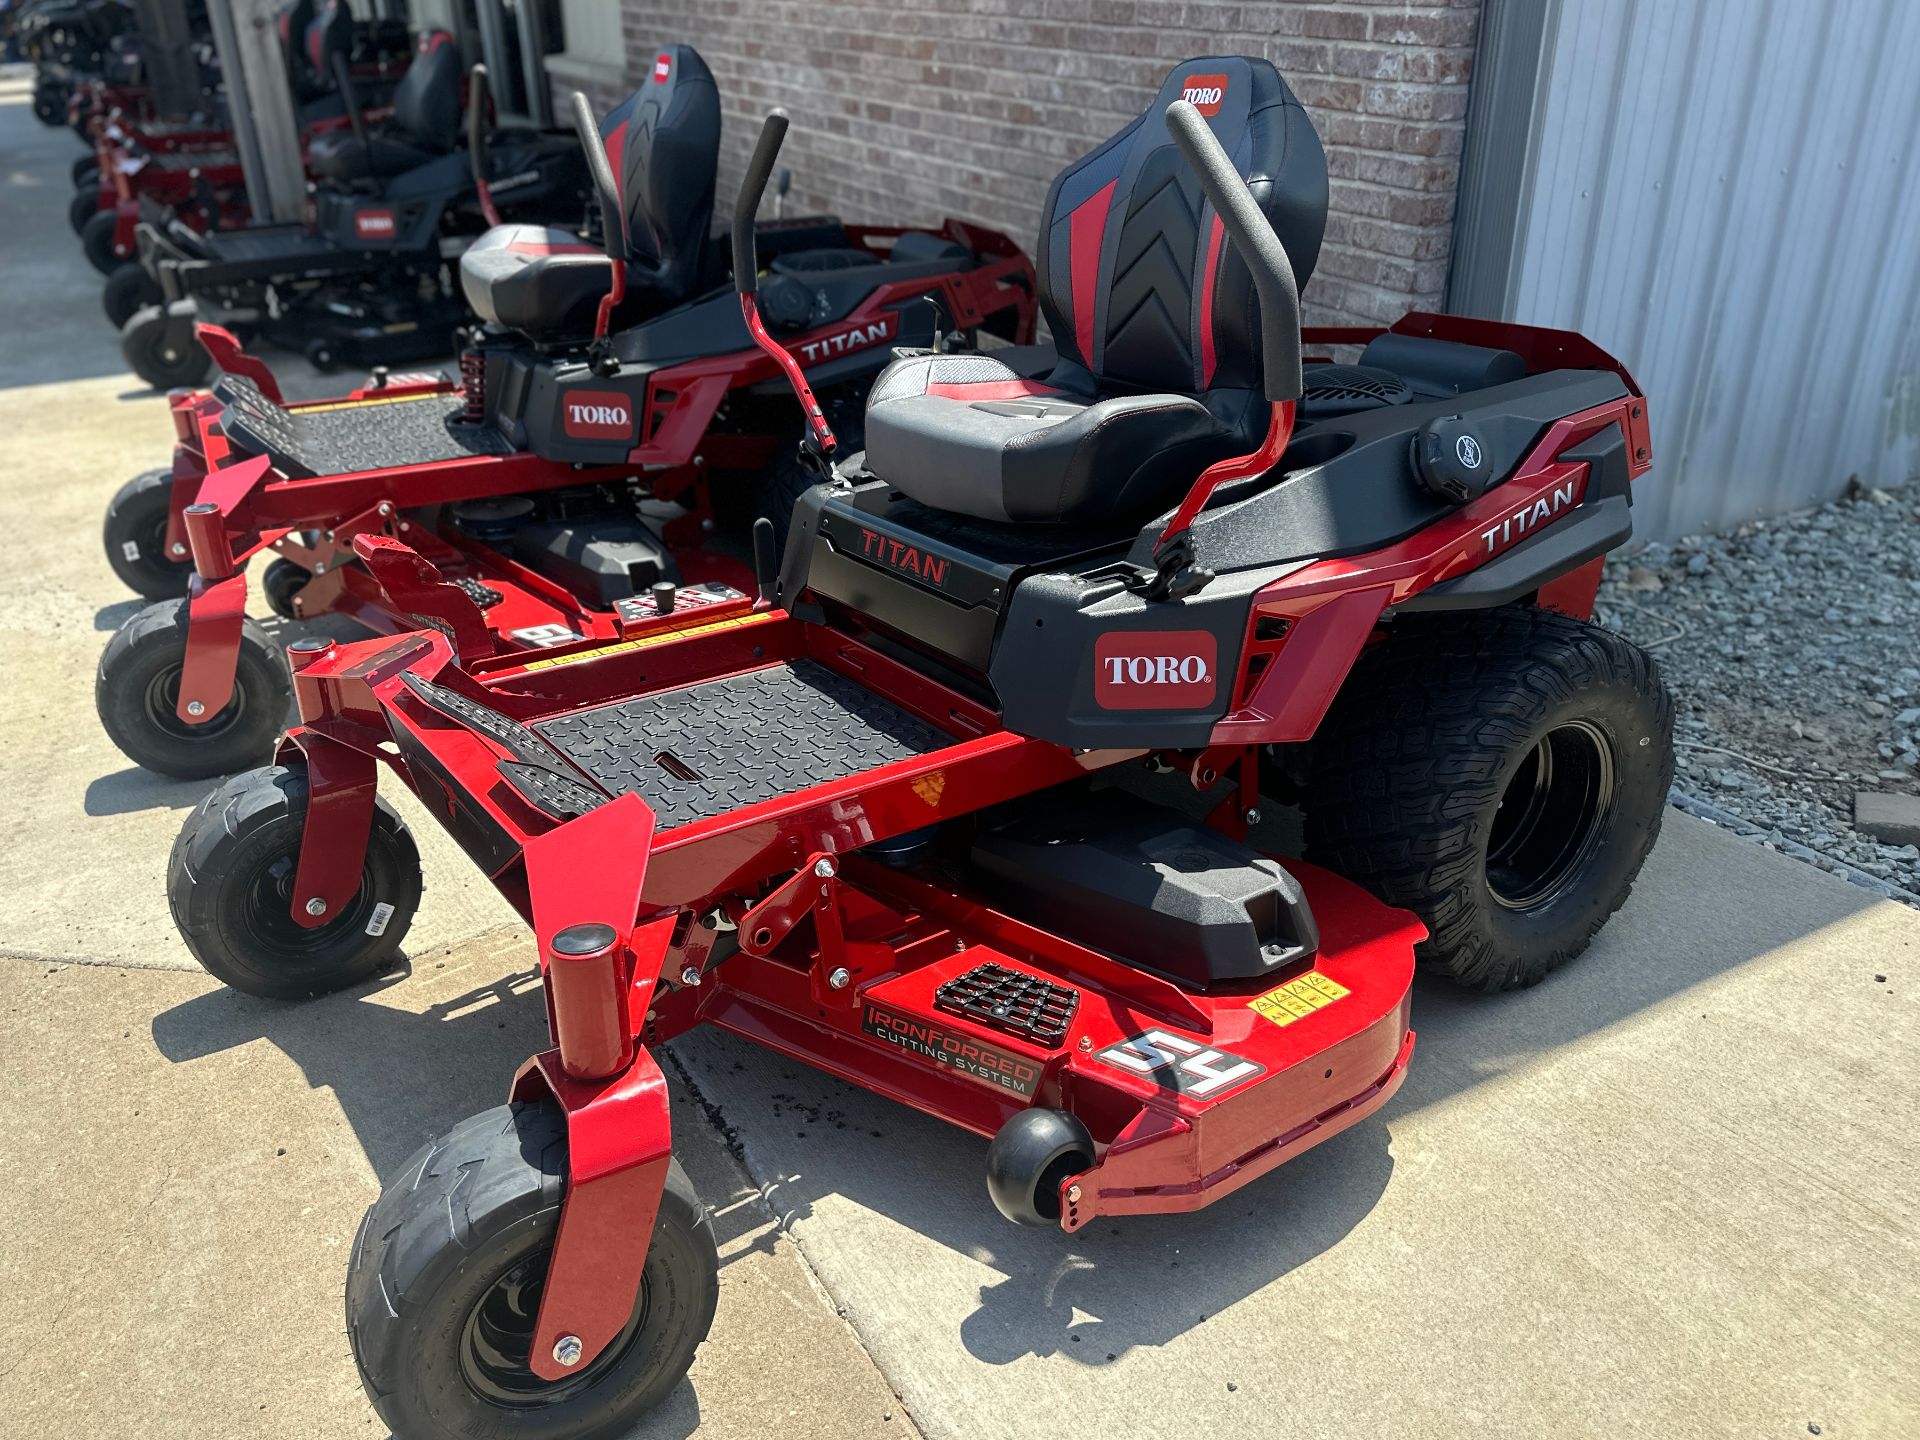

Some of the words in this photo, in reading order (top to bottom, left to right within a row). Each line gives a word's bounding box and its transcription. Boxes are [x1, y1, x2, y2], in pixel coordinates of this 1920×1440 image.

[1183, 88, 1222, 105] TORO
[801, 321, 887, 361] TITAN
[569, 405, 628, 425] TORO
[1481, 481, 1573, 554] TITAN
[862, 528, 945, 585] TITAN
[1104, 655, 1207, 684] TORO
[868, 1006, 1034, 1081] IRONFORGED
[877, 1028, 948, 1062] CUTTING
[955, 1057, 1026, 1093] SYSTEM
[1099, 1030, 1259, 1096] 54
